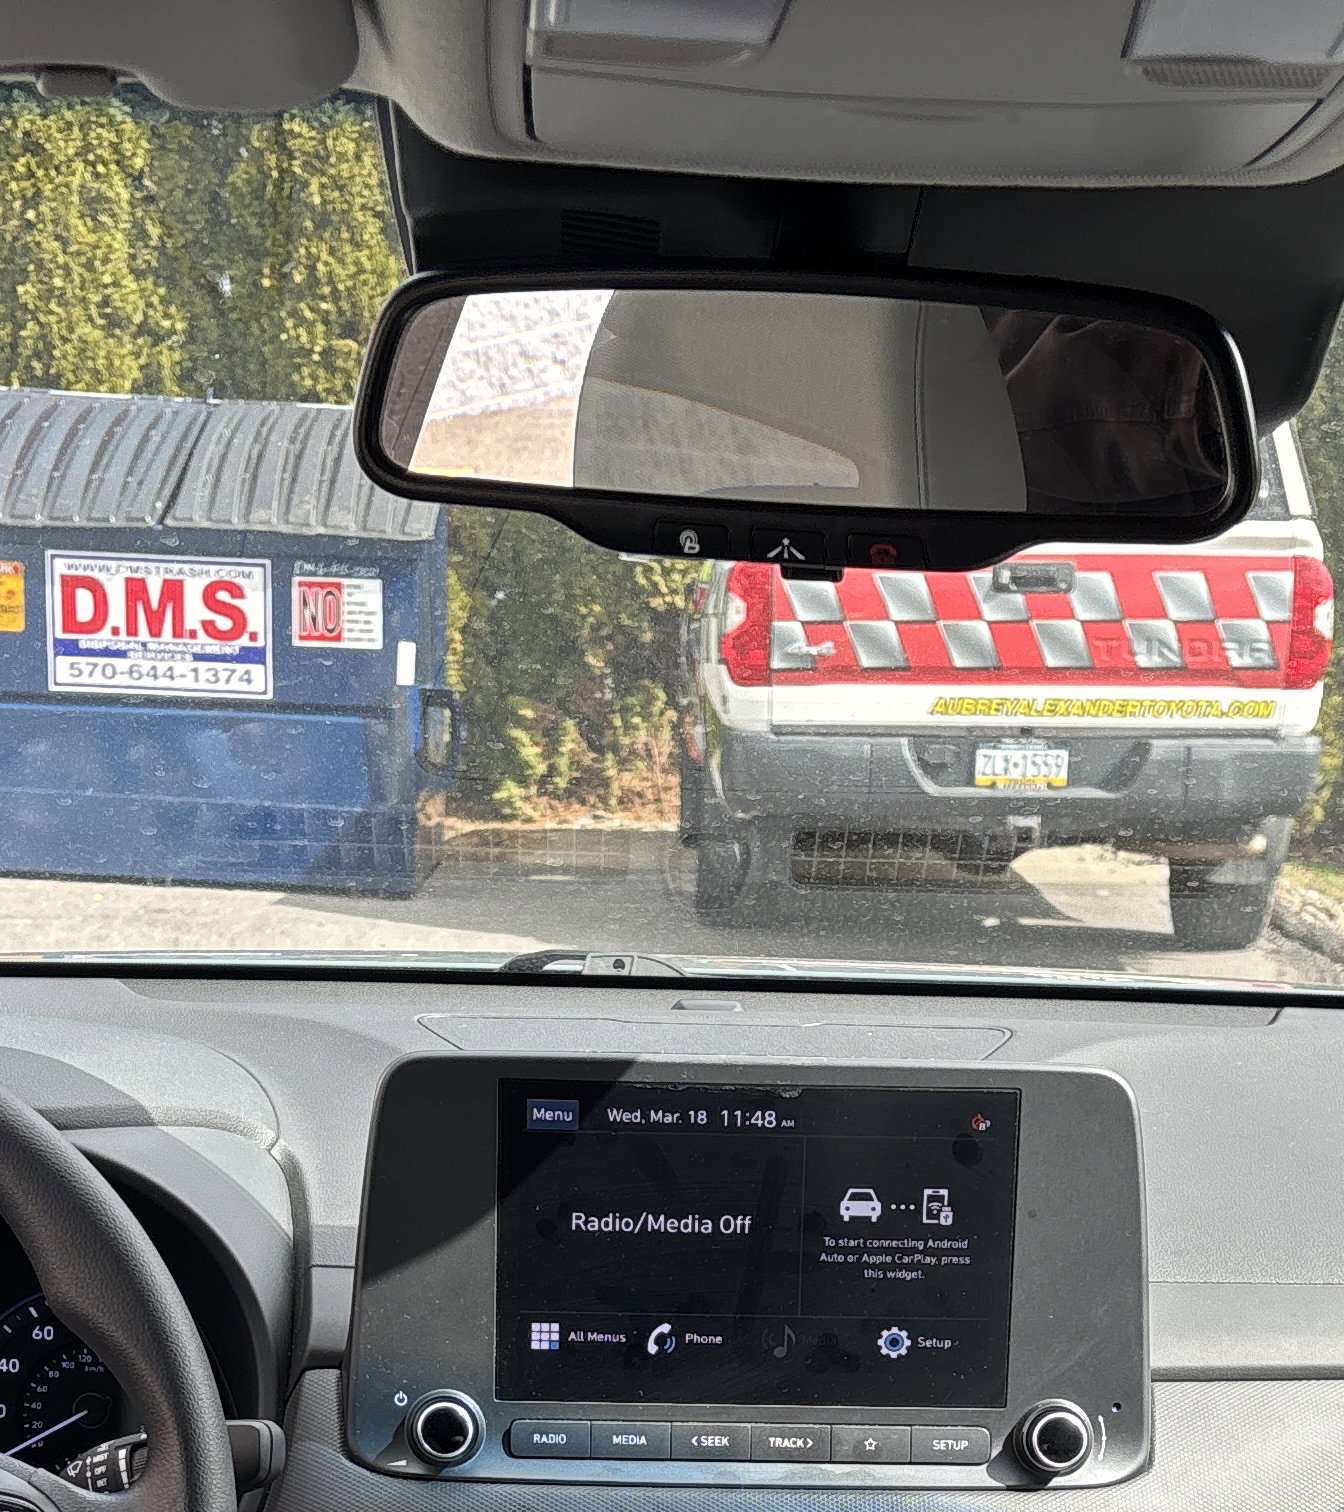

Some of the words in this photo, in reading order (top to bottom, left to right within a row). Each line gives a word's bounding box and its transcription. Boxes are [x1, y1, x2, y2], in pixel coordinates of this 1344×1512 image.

[60, 574, 259, 643] D.M.S.
[298, 586, 342, 638] NO
[68, 661, 255, 686] 570-644-1374
[929, 696, 1279, 720] AUBREYALEXANDERTOYOTA.COM
[532, 1107, 573, 1121] Menu
[607, 1107, 646, 1125] Wed,
[650, 1109, 683, 1124] Mar.
[689, 1110, 707, 1125] 18
[720, 1110, 777, 1128] 11:48
[781, 1119, 795, 1128] AM
[571, 1211, 713, 1235] Radio/Media
[719, 1214, 753, 1235] Off
[823, 1236, 836, 1247] To
[838, 1237, 864, 1248] start
[866, 1237, 924, 1250] connecting
[926, 1238, 969, 1250] Android
[819, 1252, 844, 1263] Auto
[847, 1254, 859, 1263] or
[861, 1253, 893, 1265] Apple
[940, 1255, 971, 1266] press
[864, 1268, 884, 1279] this
[886, 1269, 926, 1281] widget.
[32, 1325, 54, 1340] 60
[568, 1331, 585, 1342] All
[587, 1331, 627, 1343] Menus
[685, 1332, 723, 1344] Phone
[917, 1336, 952, 1349] Setup
[533, 1433, 567, 1445] RADIO
[612, 1434, 647, 1446] MEDIA
[932, 1438, 969, 1451] SETUP
